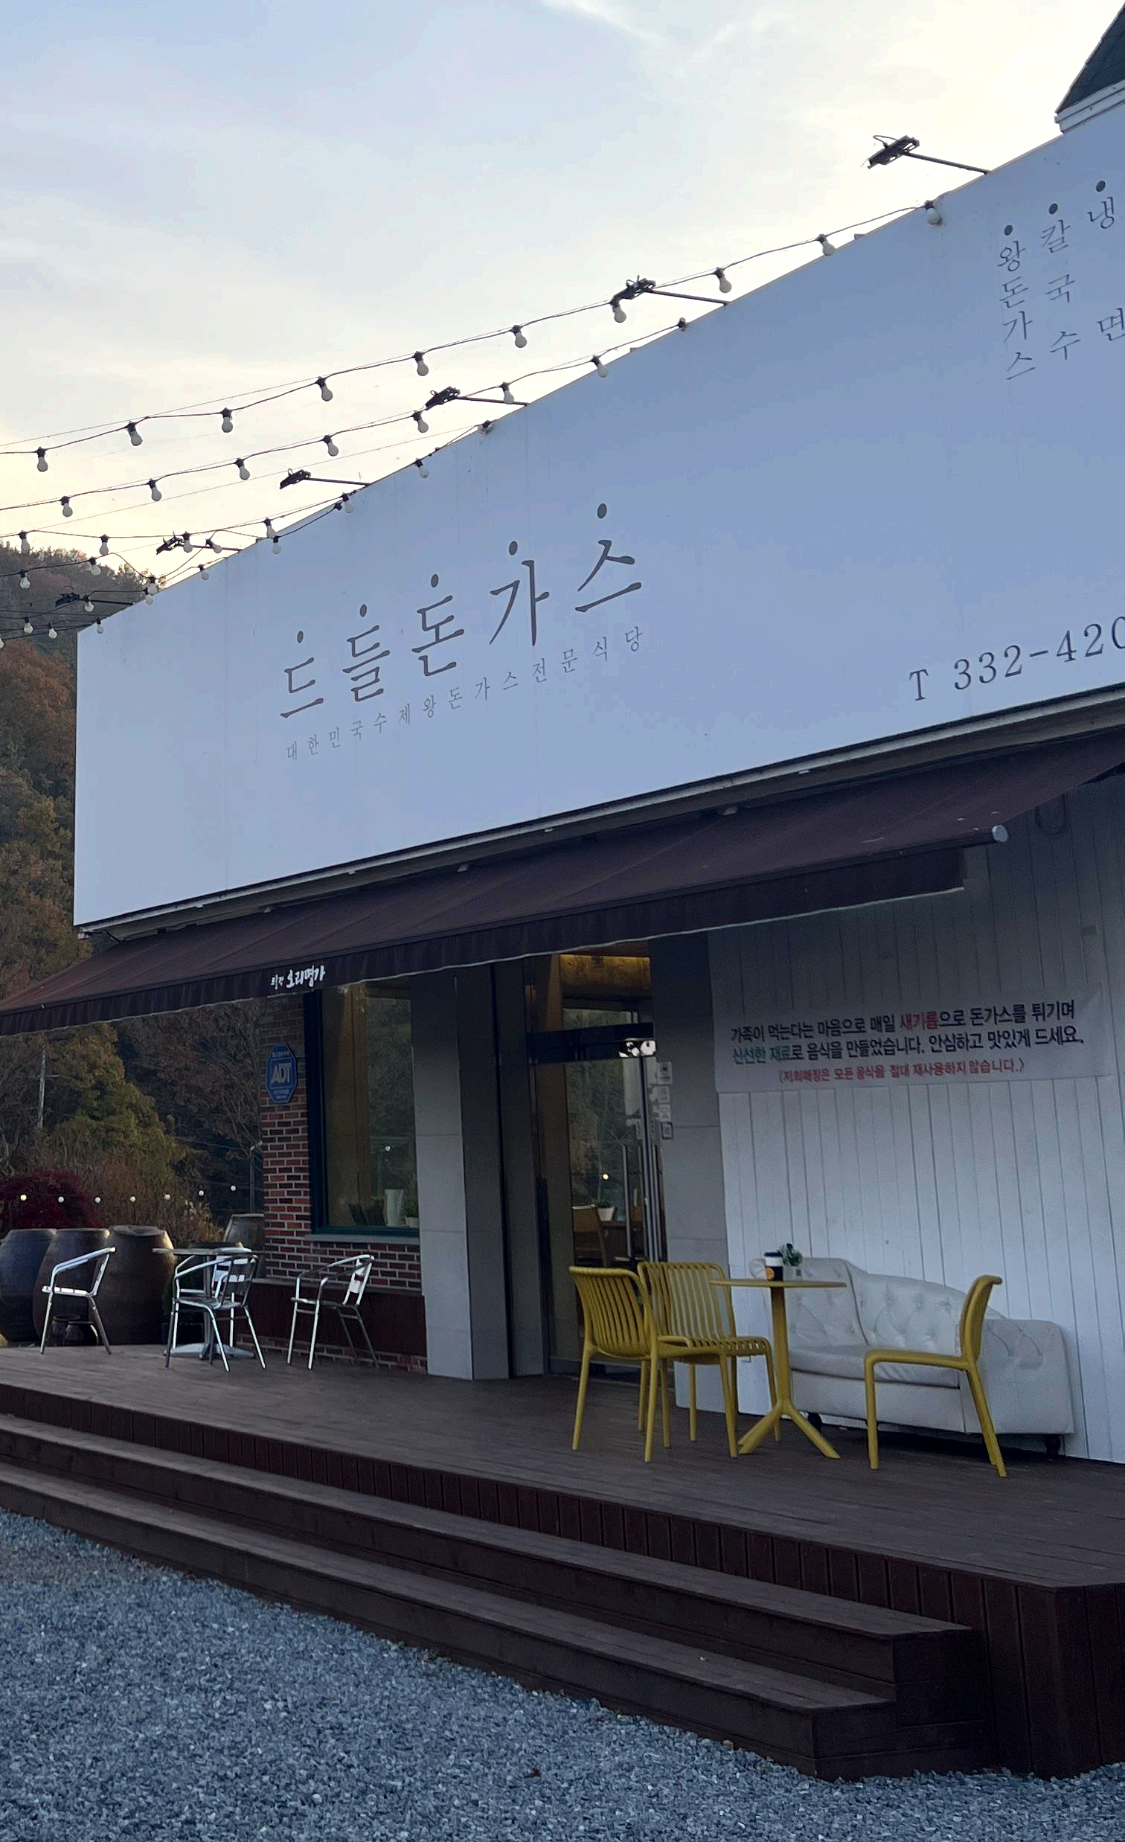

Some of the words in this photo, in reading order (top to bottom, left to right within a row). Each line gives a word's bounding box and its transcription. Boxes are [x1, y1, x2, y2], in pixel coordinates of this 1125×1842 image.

[1040, 219, 1081, 360] 칼국수
[1087, 197, 1125, 341] 냉면
[997, 240, 1036, 380] 왕돈가스
[909, 668, 929, 701] T
[731, 1025, 765, 1044] 가족이
[768, 1021, 814, 1041] 먹는다는
[818, 1017, 866, 1037] 마음으로
[870, 1014, 895, 1033] 매일
[900, 1009, 966, 1031] 새기름으로
[970, 1004, 1027, 1026] 돈가스를
[1031, 999, 1075, 1021] 튀기며
[732, 1046, 766, 1064] 신선한
[769, 1044, 804, 1062] 재료로
[806, 1041, 842, 1060] 음식을
[846, 1035, 925, 1058] 만들었습니다.
[928, 1032, 984, 1053] 안심하고
[988, 1028, 1031, 1049] 맛있게
[1035, 1025, 1084, 1045] 드세요.
[270, 1062, 292, 1084] ADT
[834, 1067, 853, 1080] 모든
[856, 1064, 885, 1080] 음식을
[913, 1061, 966, 1077] 재사용하지
